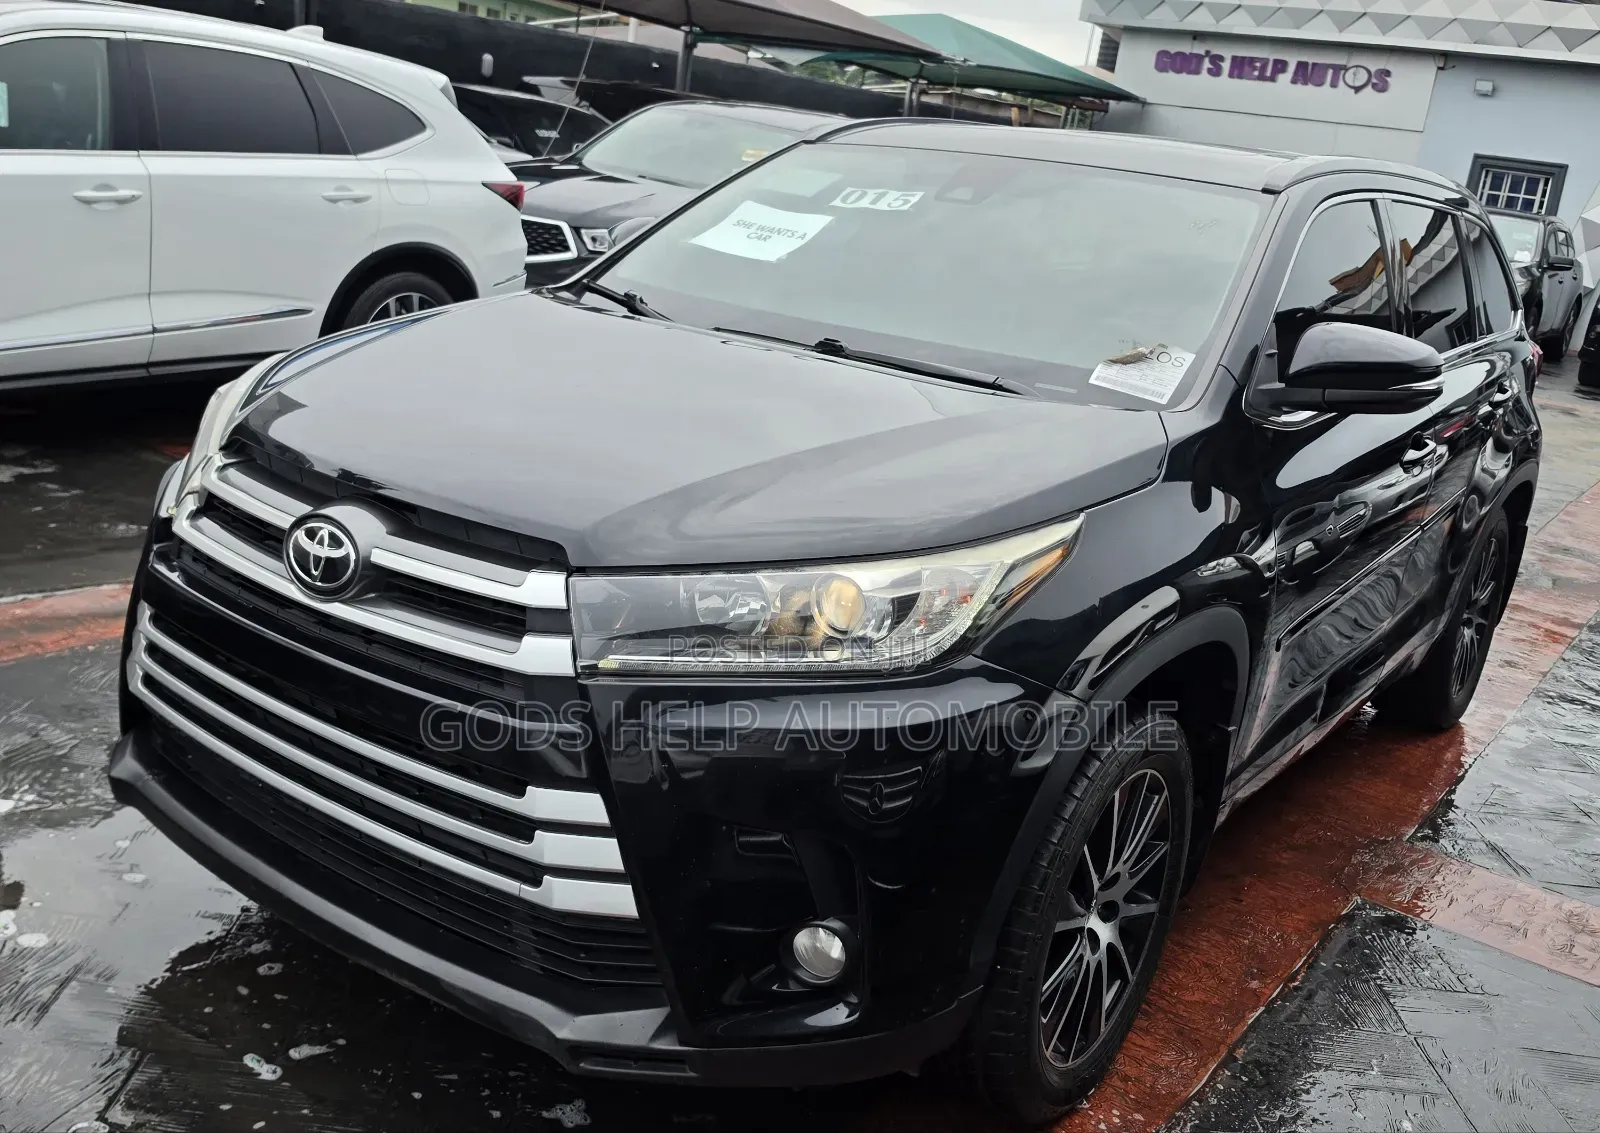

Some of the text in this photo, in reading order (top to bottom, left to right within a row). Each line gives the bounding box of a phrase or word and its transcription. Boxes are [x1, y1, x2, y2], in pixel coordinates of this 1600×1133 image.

[1228, 55, 1289, 83] HELP
[1290, 60, 1392, 94] AUTOS
[839, 188, 917, 209] 015
[732, 219, 808, 241] SHE WANTS A
[746, 232, 773, 242] CAR
